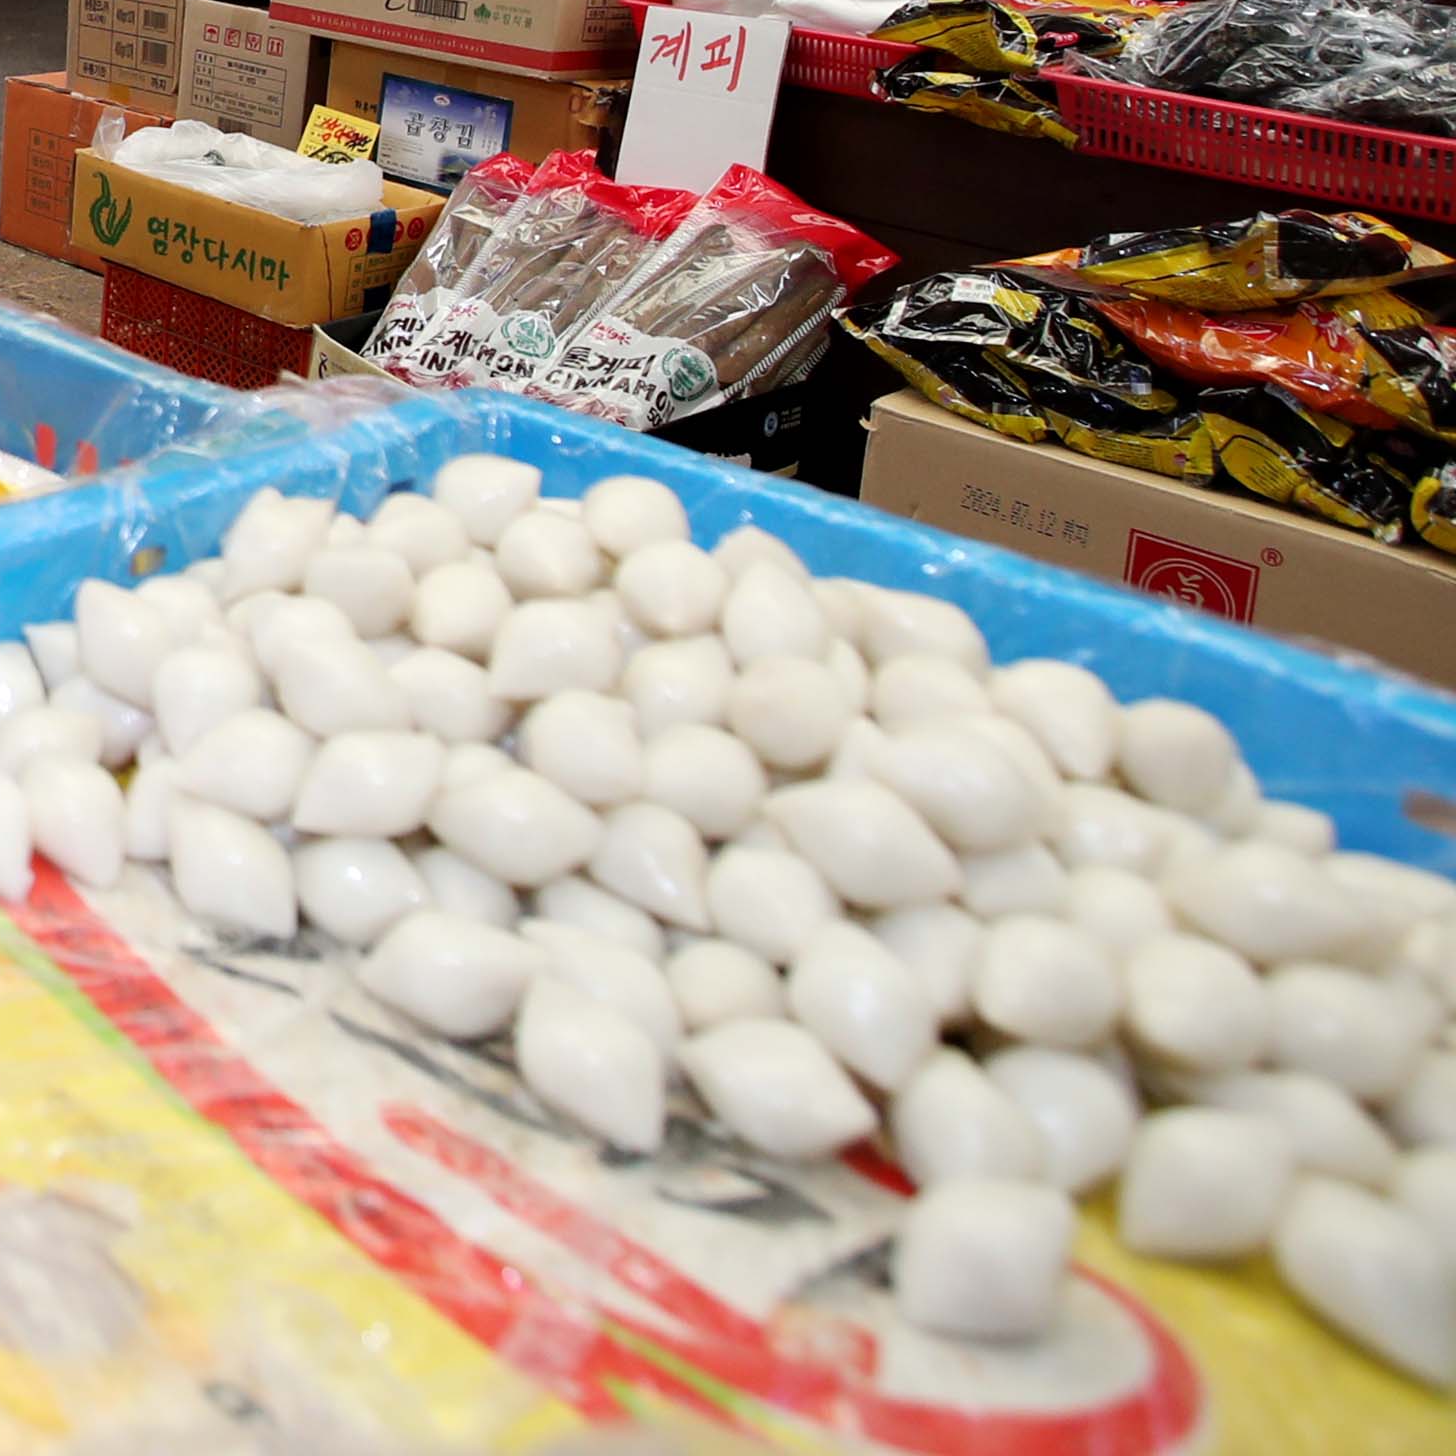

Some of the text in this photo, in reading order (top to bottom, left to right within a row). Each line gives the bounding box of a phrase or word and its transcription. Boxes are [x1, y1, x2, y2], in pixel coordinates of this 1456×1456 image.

[648, 23, 748, 92] 계피
[403, 110, 476, 149] 곱창김
[146, 215, 291, 292] 염장다시마
